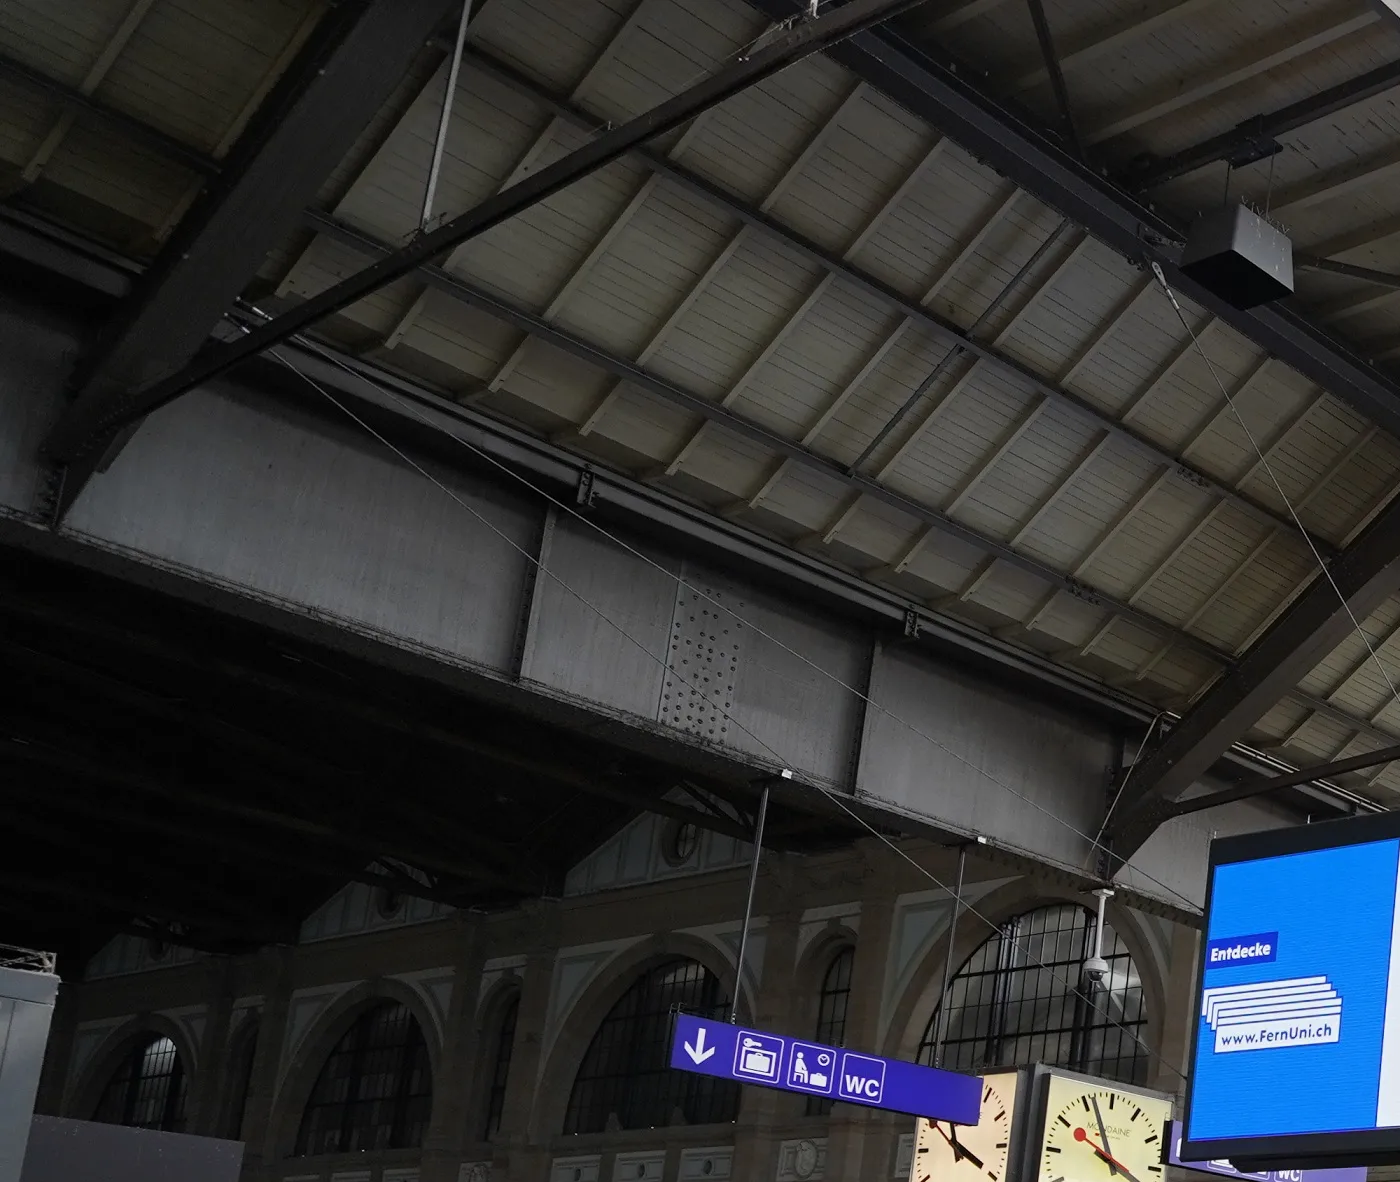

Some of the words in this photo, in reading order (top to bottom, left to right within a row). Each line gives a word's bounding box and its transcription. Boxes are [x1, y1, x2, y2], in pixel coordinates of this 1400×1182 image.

[1210, 942, 1271, 962] Entdecke
[1221, 1024, 1332, 1046] www.FernUni.ch
[845, 1074, 880, 1097] WC
[1087, 1122, 1131, 1137] MODAINE
[1278, 1170, 1300, 1182] WC
